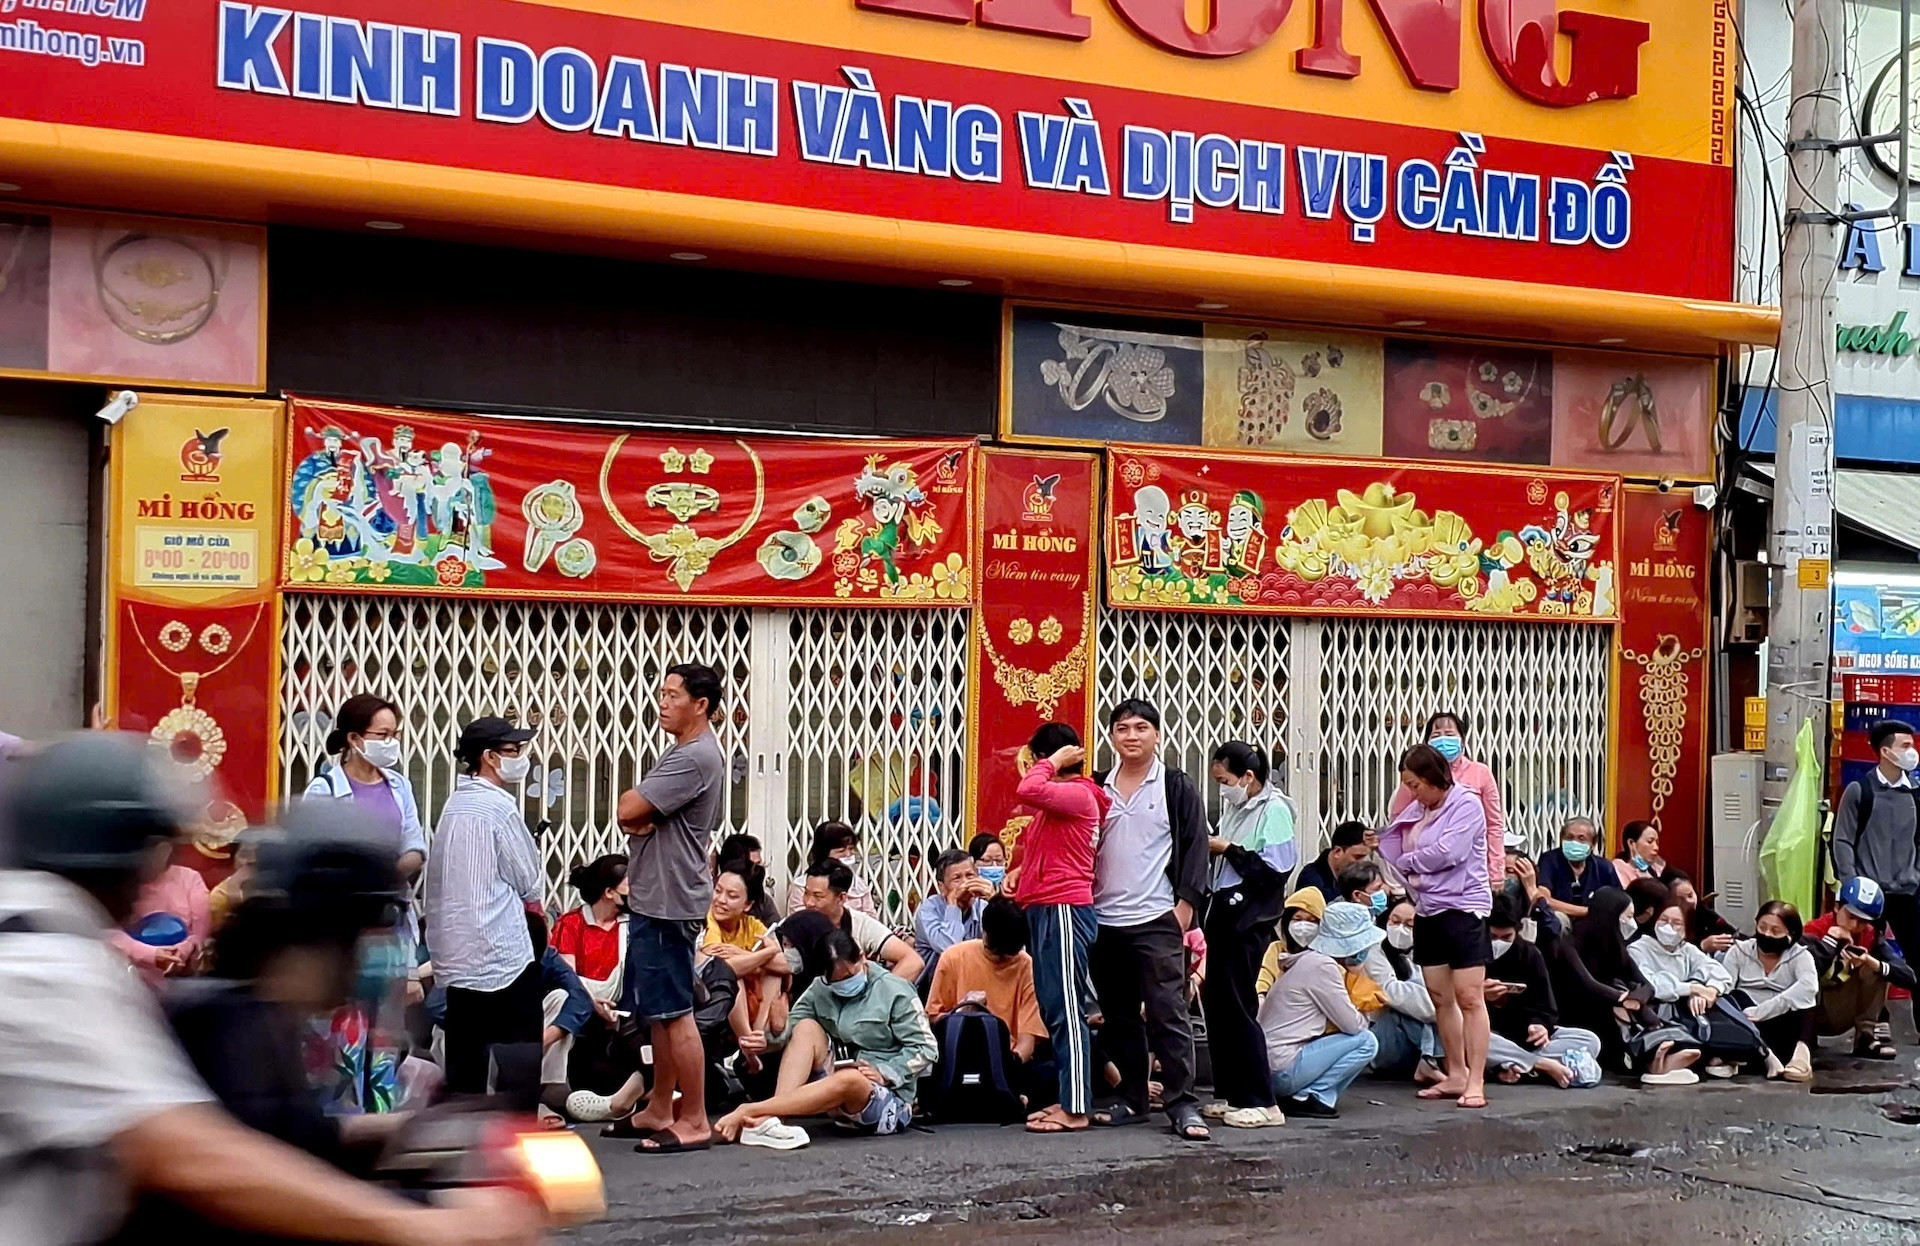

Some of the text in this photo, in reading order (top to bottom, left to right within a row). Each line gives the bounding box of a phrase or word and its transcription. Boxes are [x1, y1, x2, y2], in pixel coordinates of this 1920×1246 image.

[217, 1, 461, 117] KINH
[474, 36, 779, 157] DOANH
[793, 66, 1001, 183] VÀNG
[1018, 97, 1110, 195] VÀ
[1122, 125, 1285, 223] DỊCH
[1297, 145, 1387, 242] VỤ
[1397, 131, 1540, 241] CẦM
[1549, 151, 1631, 249] ĐỒ
[179, 491, 255, 520] HỒNG
[1022, 527, 1077, 553] HỒNG
[1653, 557, 1695, 578] HỒNG
